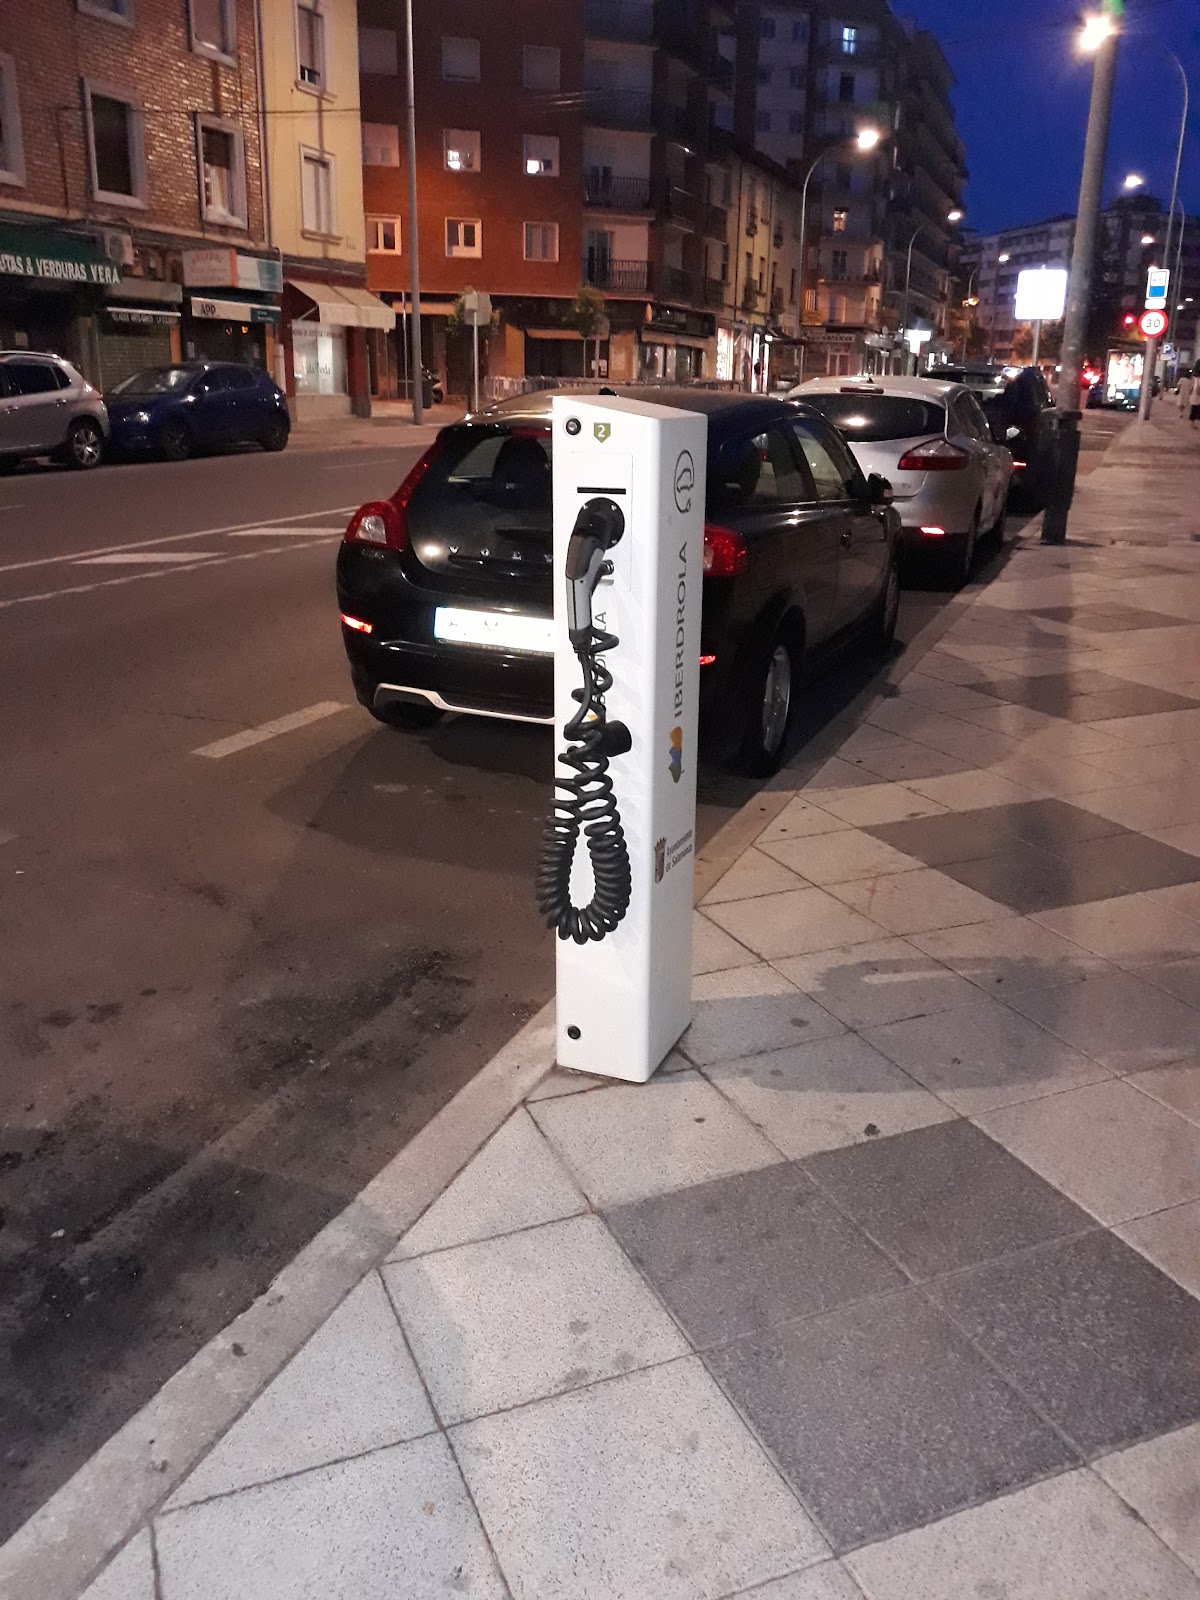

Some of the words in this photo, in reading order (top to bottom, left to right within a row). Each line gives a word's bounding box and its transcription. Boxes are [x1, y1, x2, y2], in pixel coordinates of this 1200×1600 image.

[26, 257, 34, 275] &
[36, 258, 87, 281] VERDURAS
[90, 264, 121, 284] VERA
[1145, 318, 1160, 328] 30
[1162, 344, 1171, 354] P
[597, 424, 606, 438] 2
[449, 545, 553, 563] VOLV
[673, 540, 688, 719] IBERDROLA
